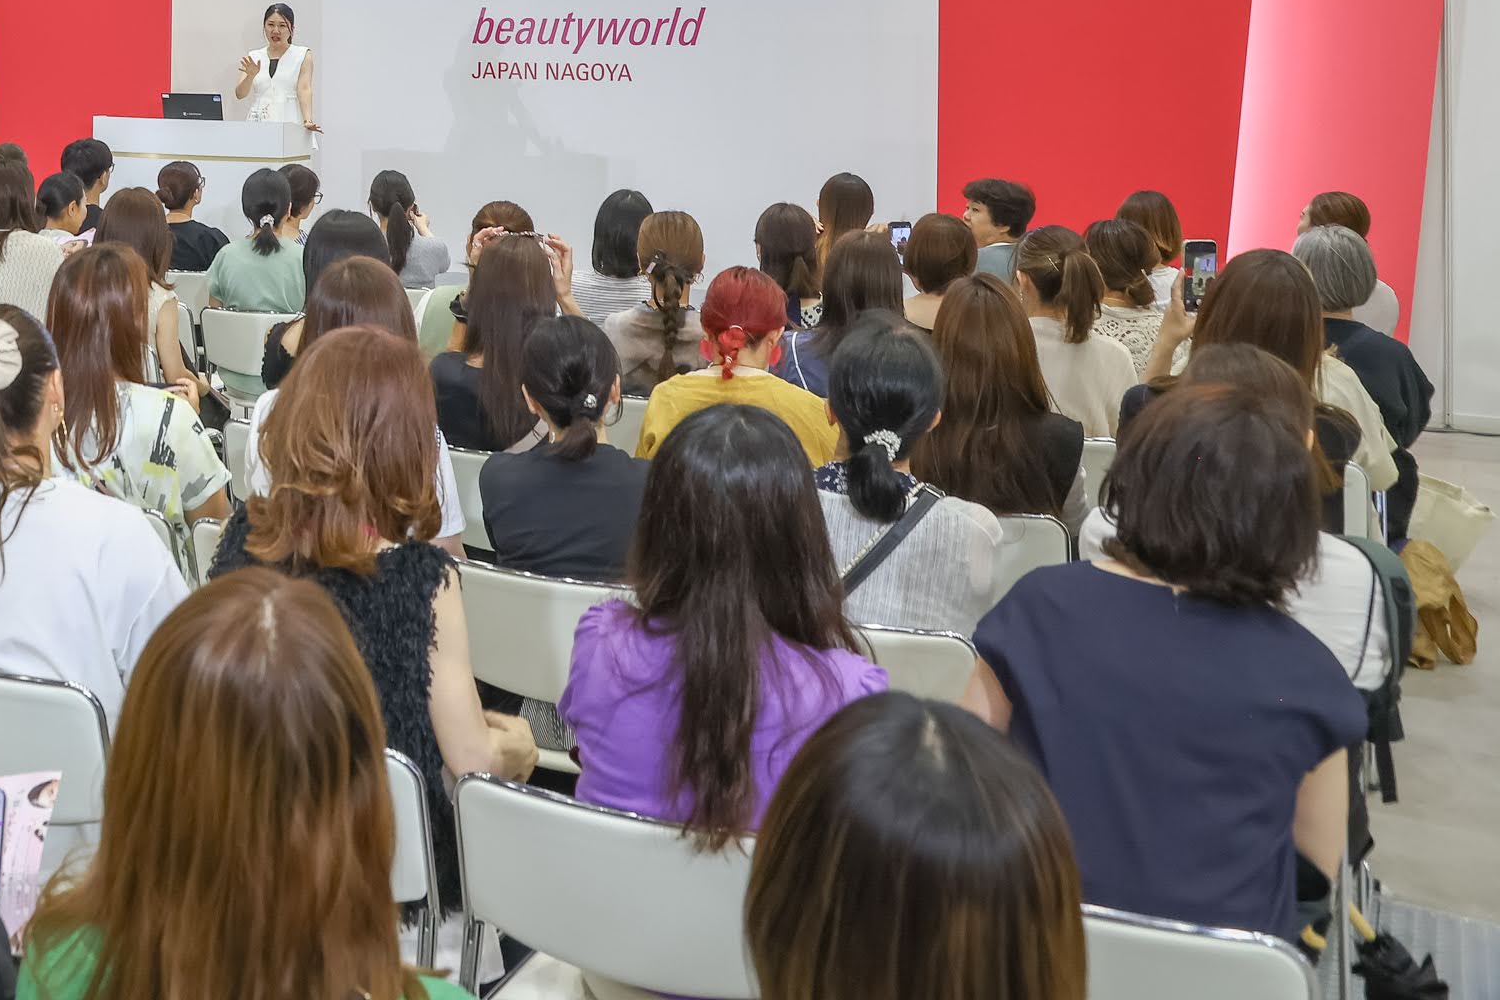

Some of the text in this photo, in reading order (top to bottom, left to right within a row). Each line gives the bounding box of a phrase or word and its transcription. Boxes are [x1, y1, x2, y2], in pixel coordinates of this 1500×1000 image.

[472, 7, 706, 54] beautyworld
[472, 62, 632, 81] JAPAN NAGOYA
